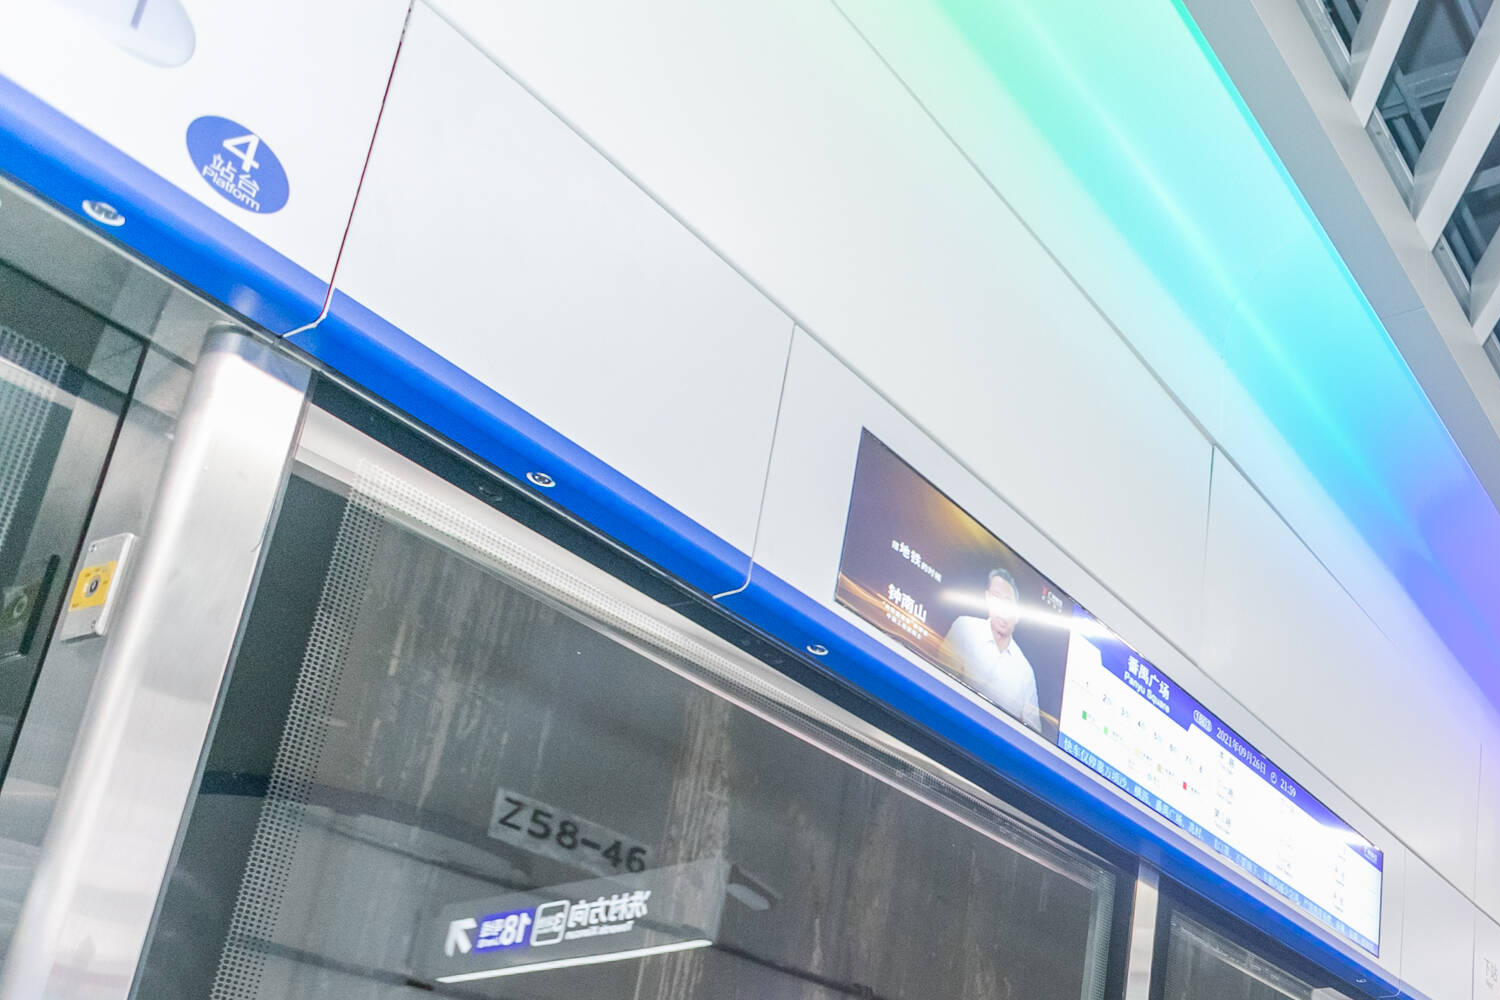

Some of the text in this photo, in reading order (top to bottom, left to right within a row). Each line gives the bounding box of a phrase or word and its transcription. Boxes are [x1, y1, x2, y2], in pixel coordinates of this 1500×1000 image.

[209, 153, 260, 198] 站台
[222, 133, 260, 173] 4
[202, 164, 261, 212] Platform
[888, 583, 927, 623] 钟南山
[1128, 655, 1170, 701] 番禺广场
[498, 797, 648, 873] Z58-46
